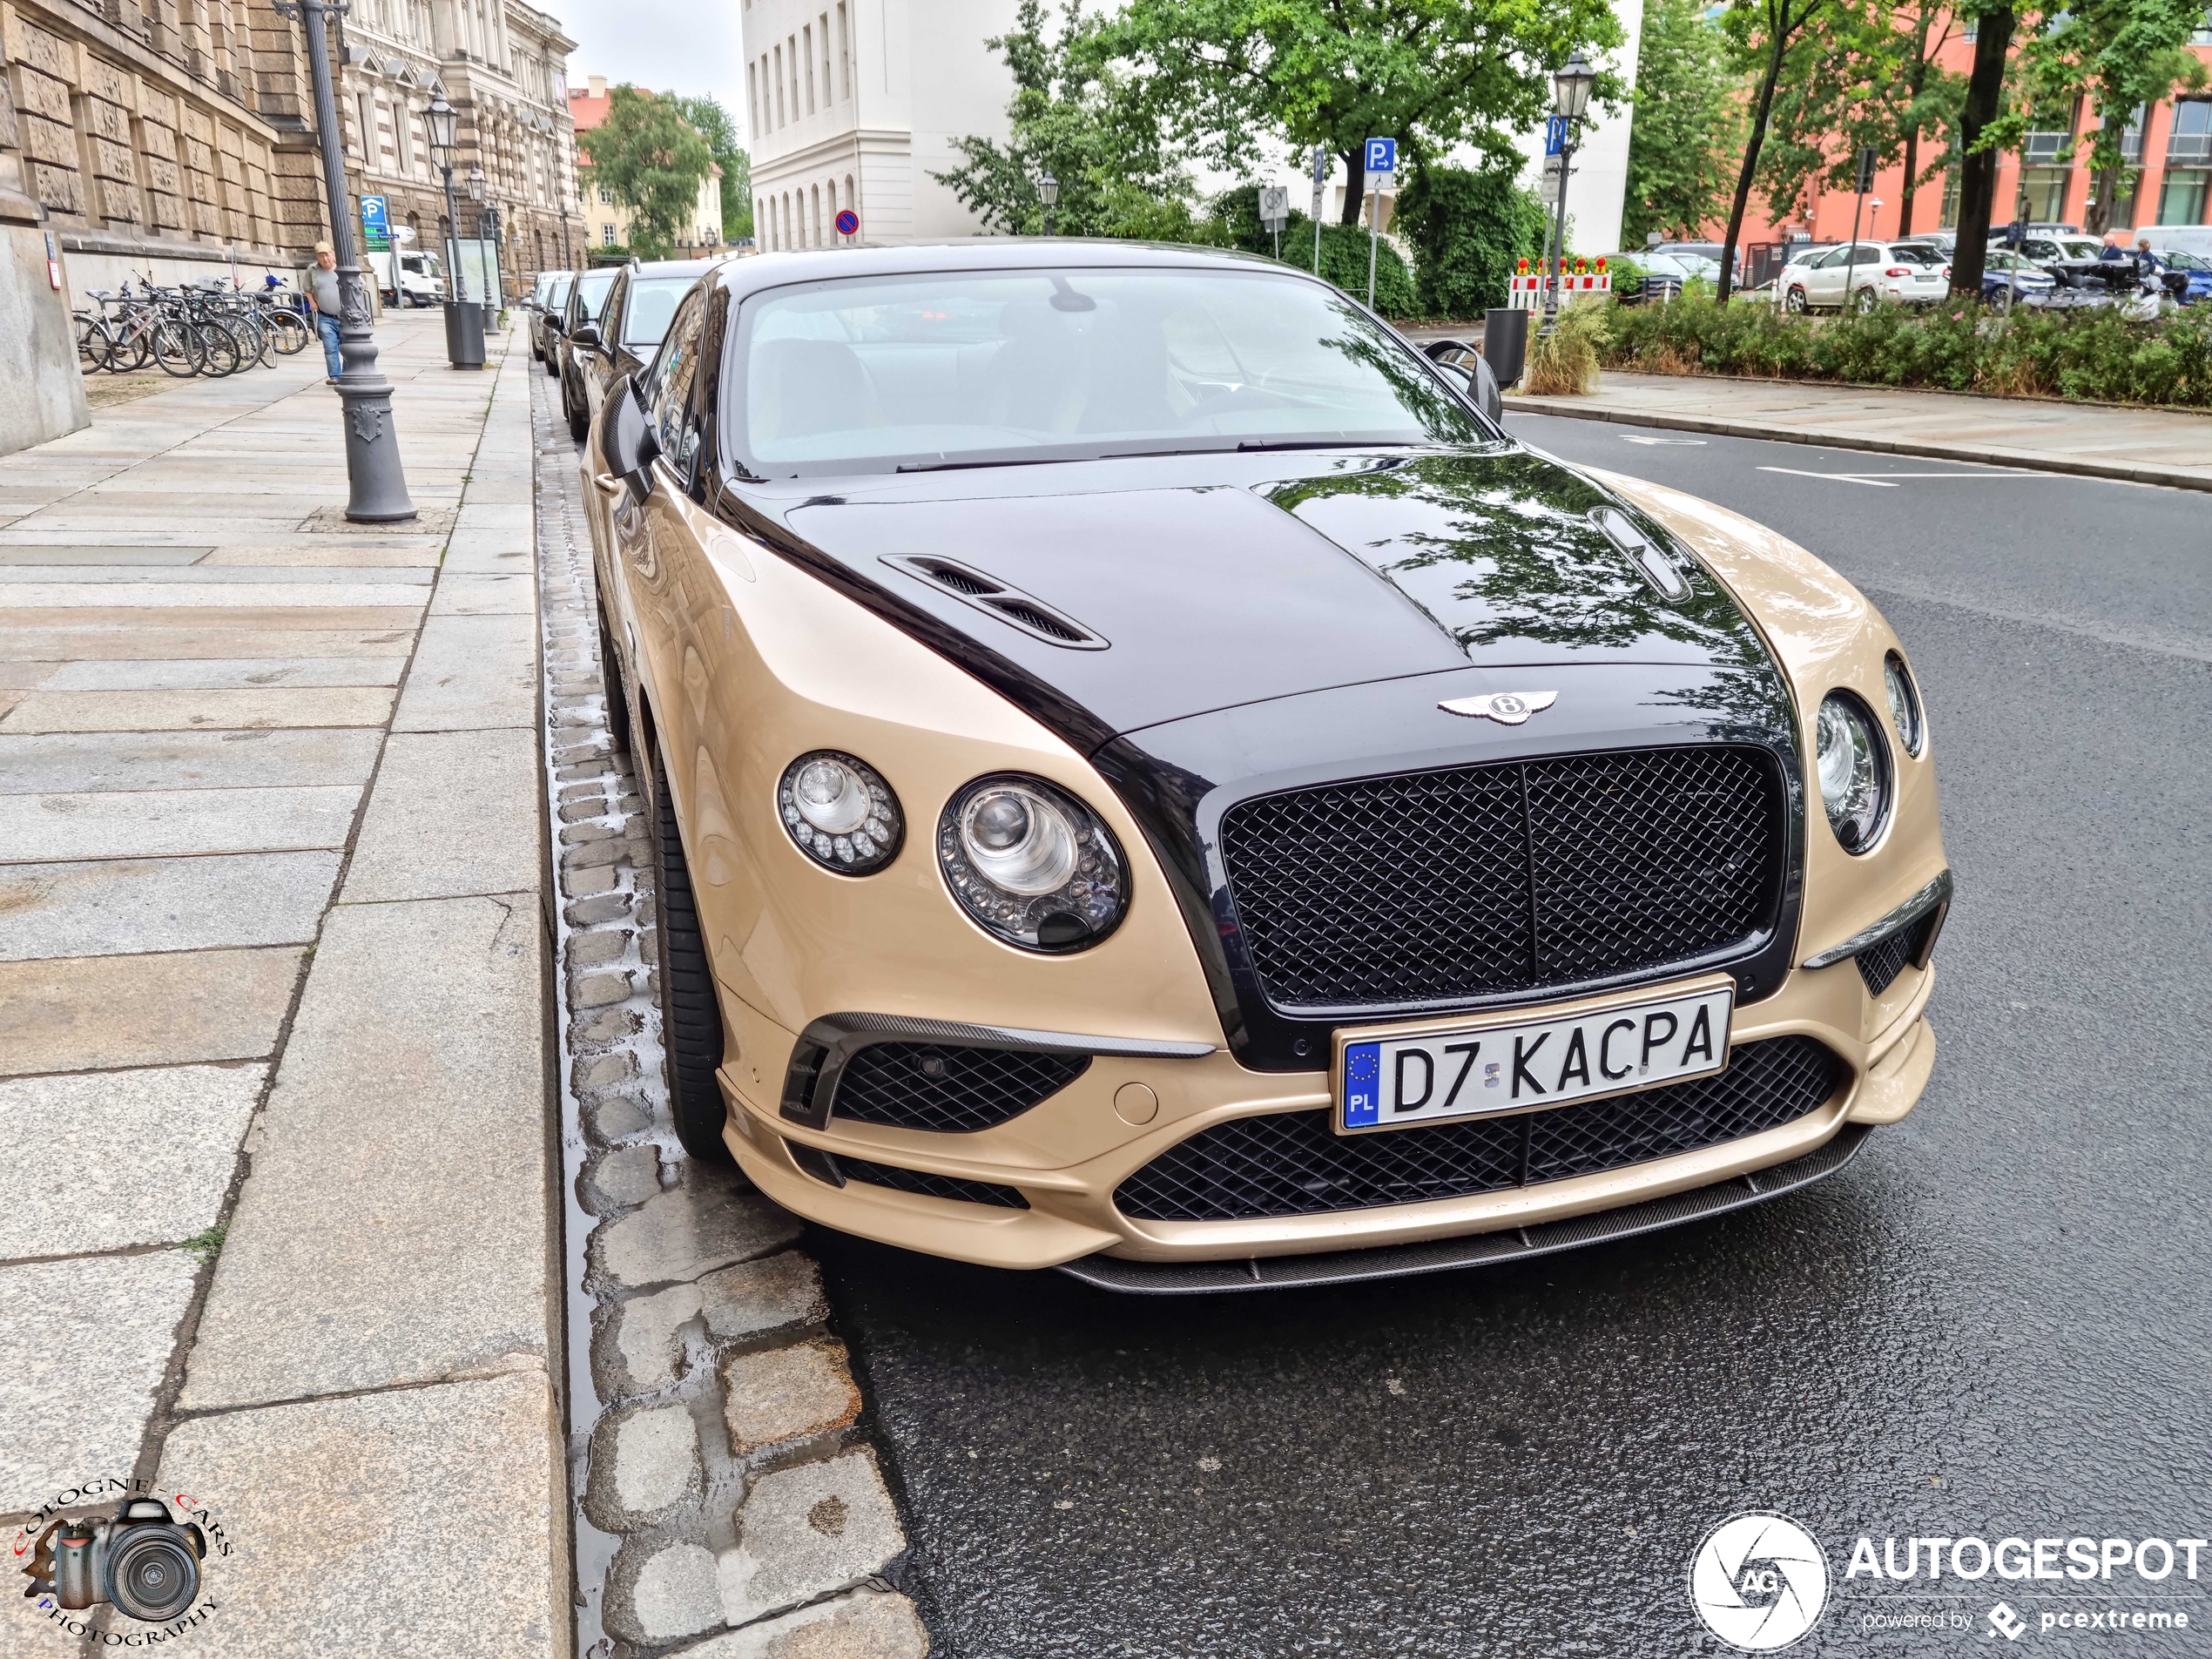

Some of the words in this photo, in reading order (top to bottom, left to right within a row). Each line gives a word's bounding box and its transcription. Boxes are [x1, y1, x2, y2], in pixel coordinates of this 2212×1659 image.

[1370, 143, 1386, 168] P
[1314, 154, 1322, 180] P
[367, 204, 378, 219] P
[1494, 696, 1521, 713] B
[1393, 1042, 1481, 1113] D7
[1510, 1002, 1713, 1099] KACPA
[1350, 1094, 1374, 1113] PL
